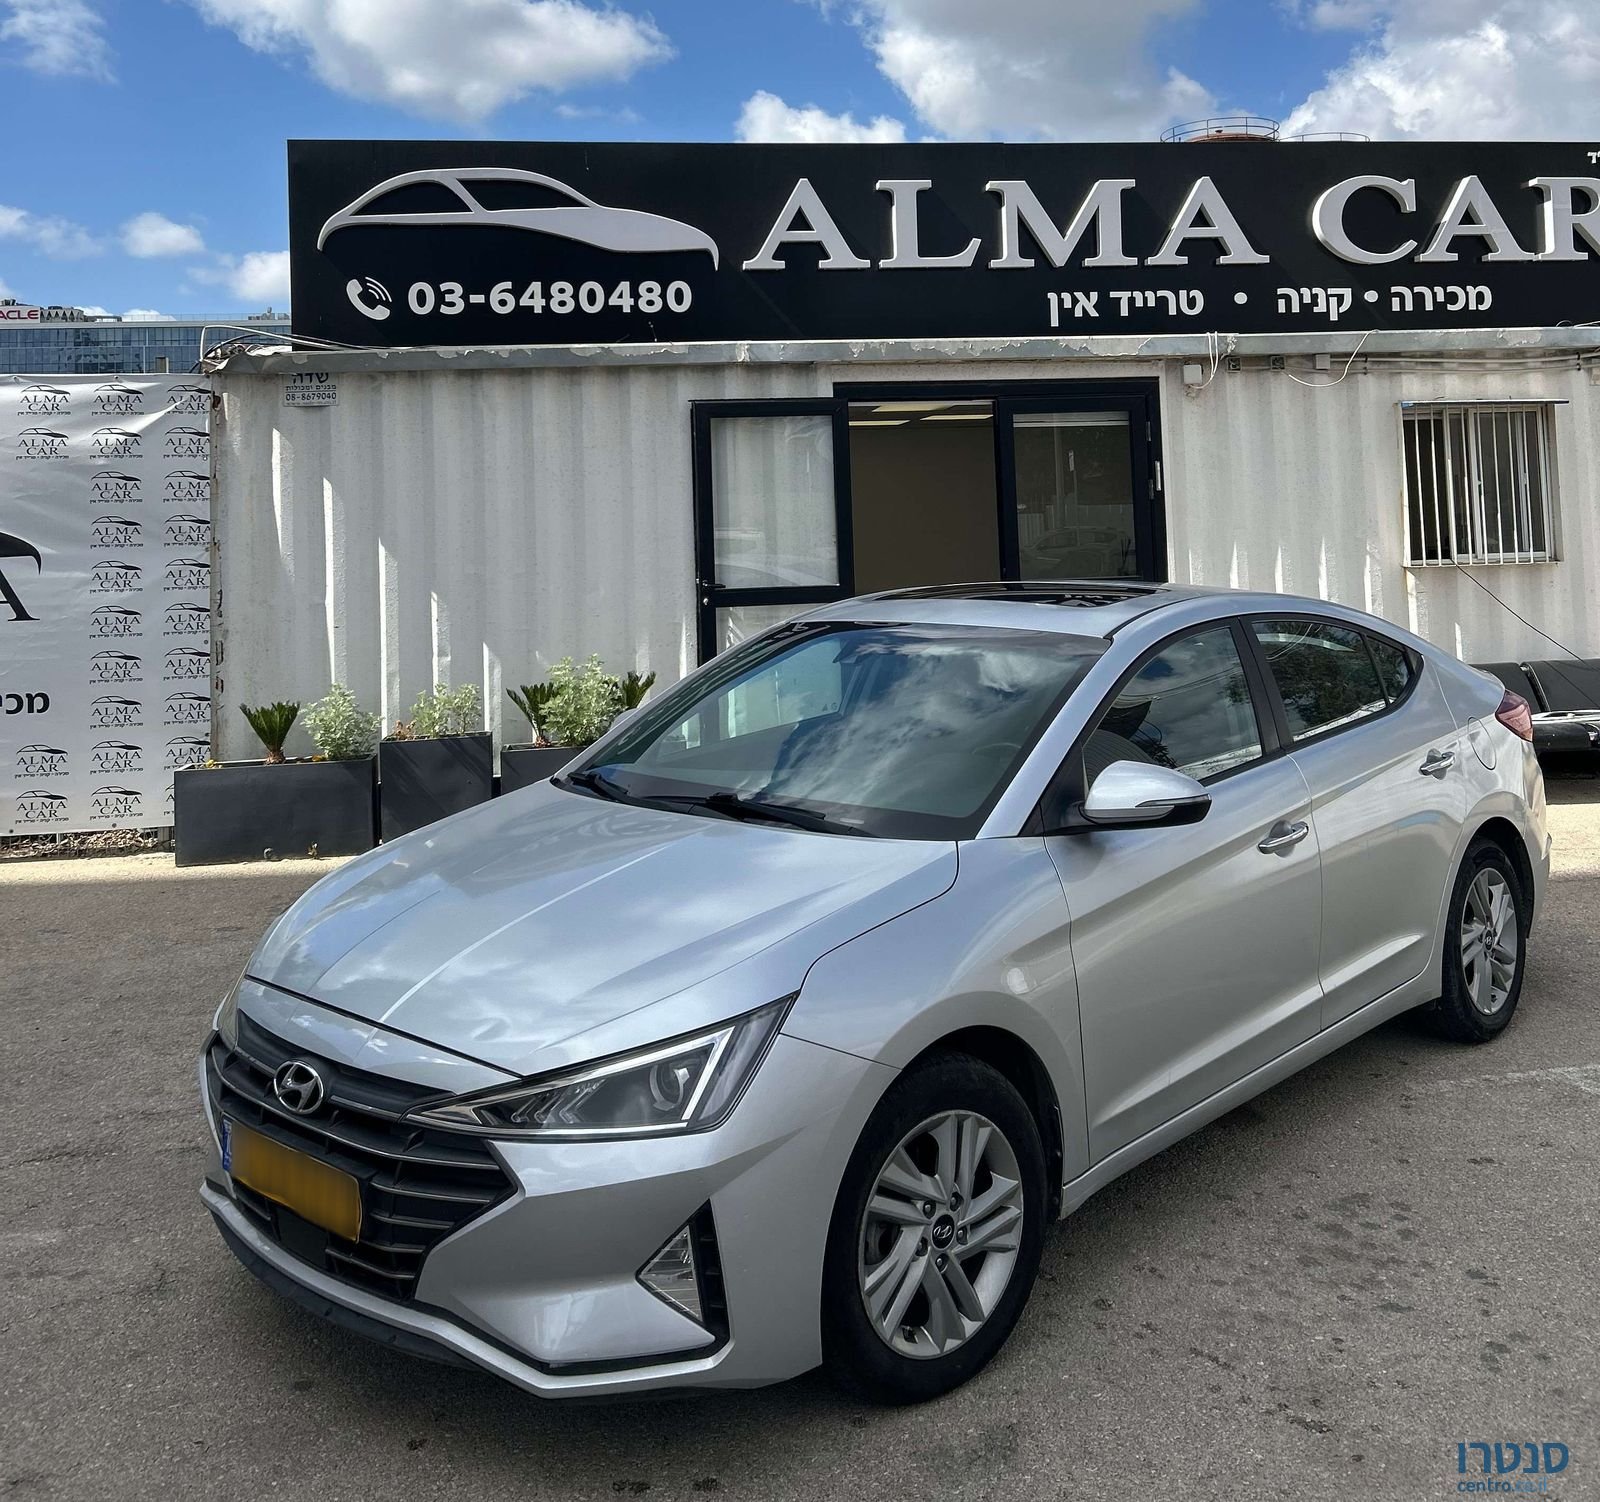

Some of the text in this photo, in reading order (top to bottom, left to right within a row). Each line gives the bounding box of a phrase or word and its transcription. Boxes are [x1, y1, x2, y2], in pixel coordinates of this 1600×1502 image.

[742, 175, 1600, 270] ALMA CAR
[407, 280, 692, 316] 03-6480480
[1047, 285, 1493, 327] מכירה קניה טרייד אין
[21, 395, 69, 403] ALMA
[95, 395, 143, 403] ALMA
[285, 392, 337, 401] 08-8679040
[19, 439, 67, 447] ALMA
[93, 438, 141, 447] ALMA
[174, 446, 205, 454] CAR
[92, 482, 141, 491] ALMA
[100, 491, 132, 499] CAR
[92, 527, 141, 535] ALMA
[101, 536, 133, 544] CAR
[174, 534, 205, 542] CAR
[92, 571, 141, 580] ALMA
[92, 617, 141, 625] ALMA
[100, 625, 132, 633] CAR
[173, 623, 205, 631] CAR
[92, 662, 141, 671] ALMA
[174, 668, 205, 676] CAR
[92, 707, 141, 716] ALMA
[174, 712, 205, 720] CAR
[17, 755, 67, 765] ALMA
[92, 751, 142, 761] ALMA
[25, 765, 58, 773] CAR
[17, 801, 67, 811] ALMA
[92, 797, 141, 807] ALMA
[100, 806, 133, 814] CAR
